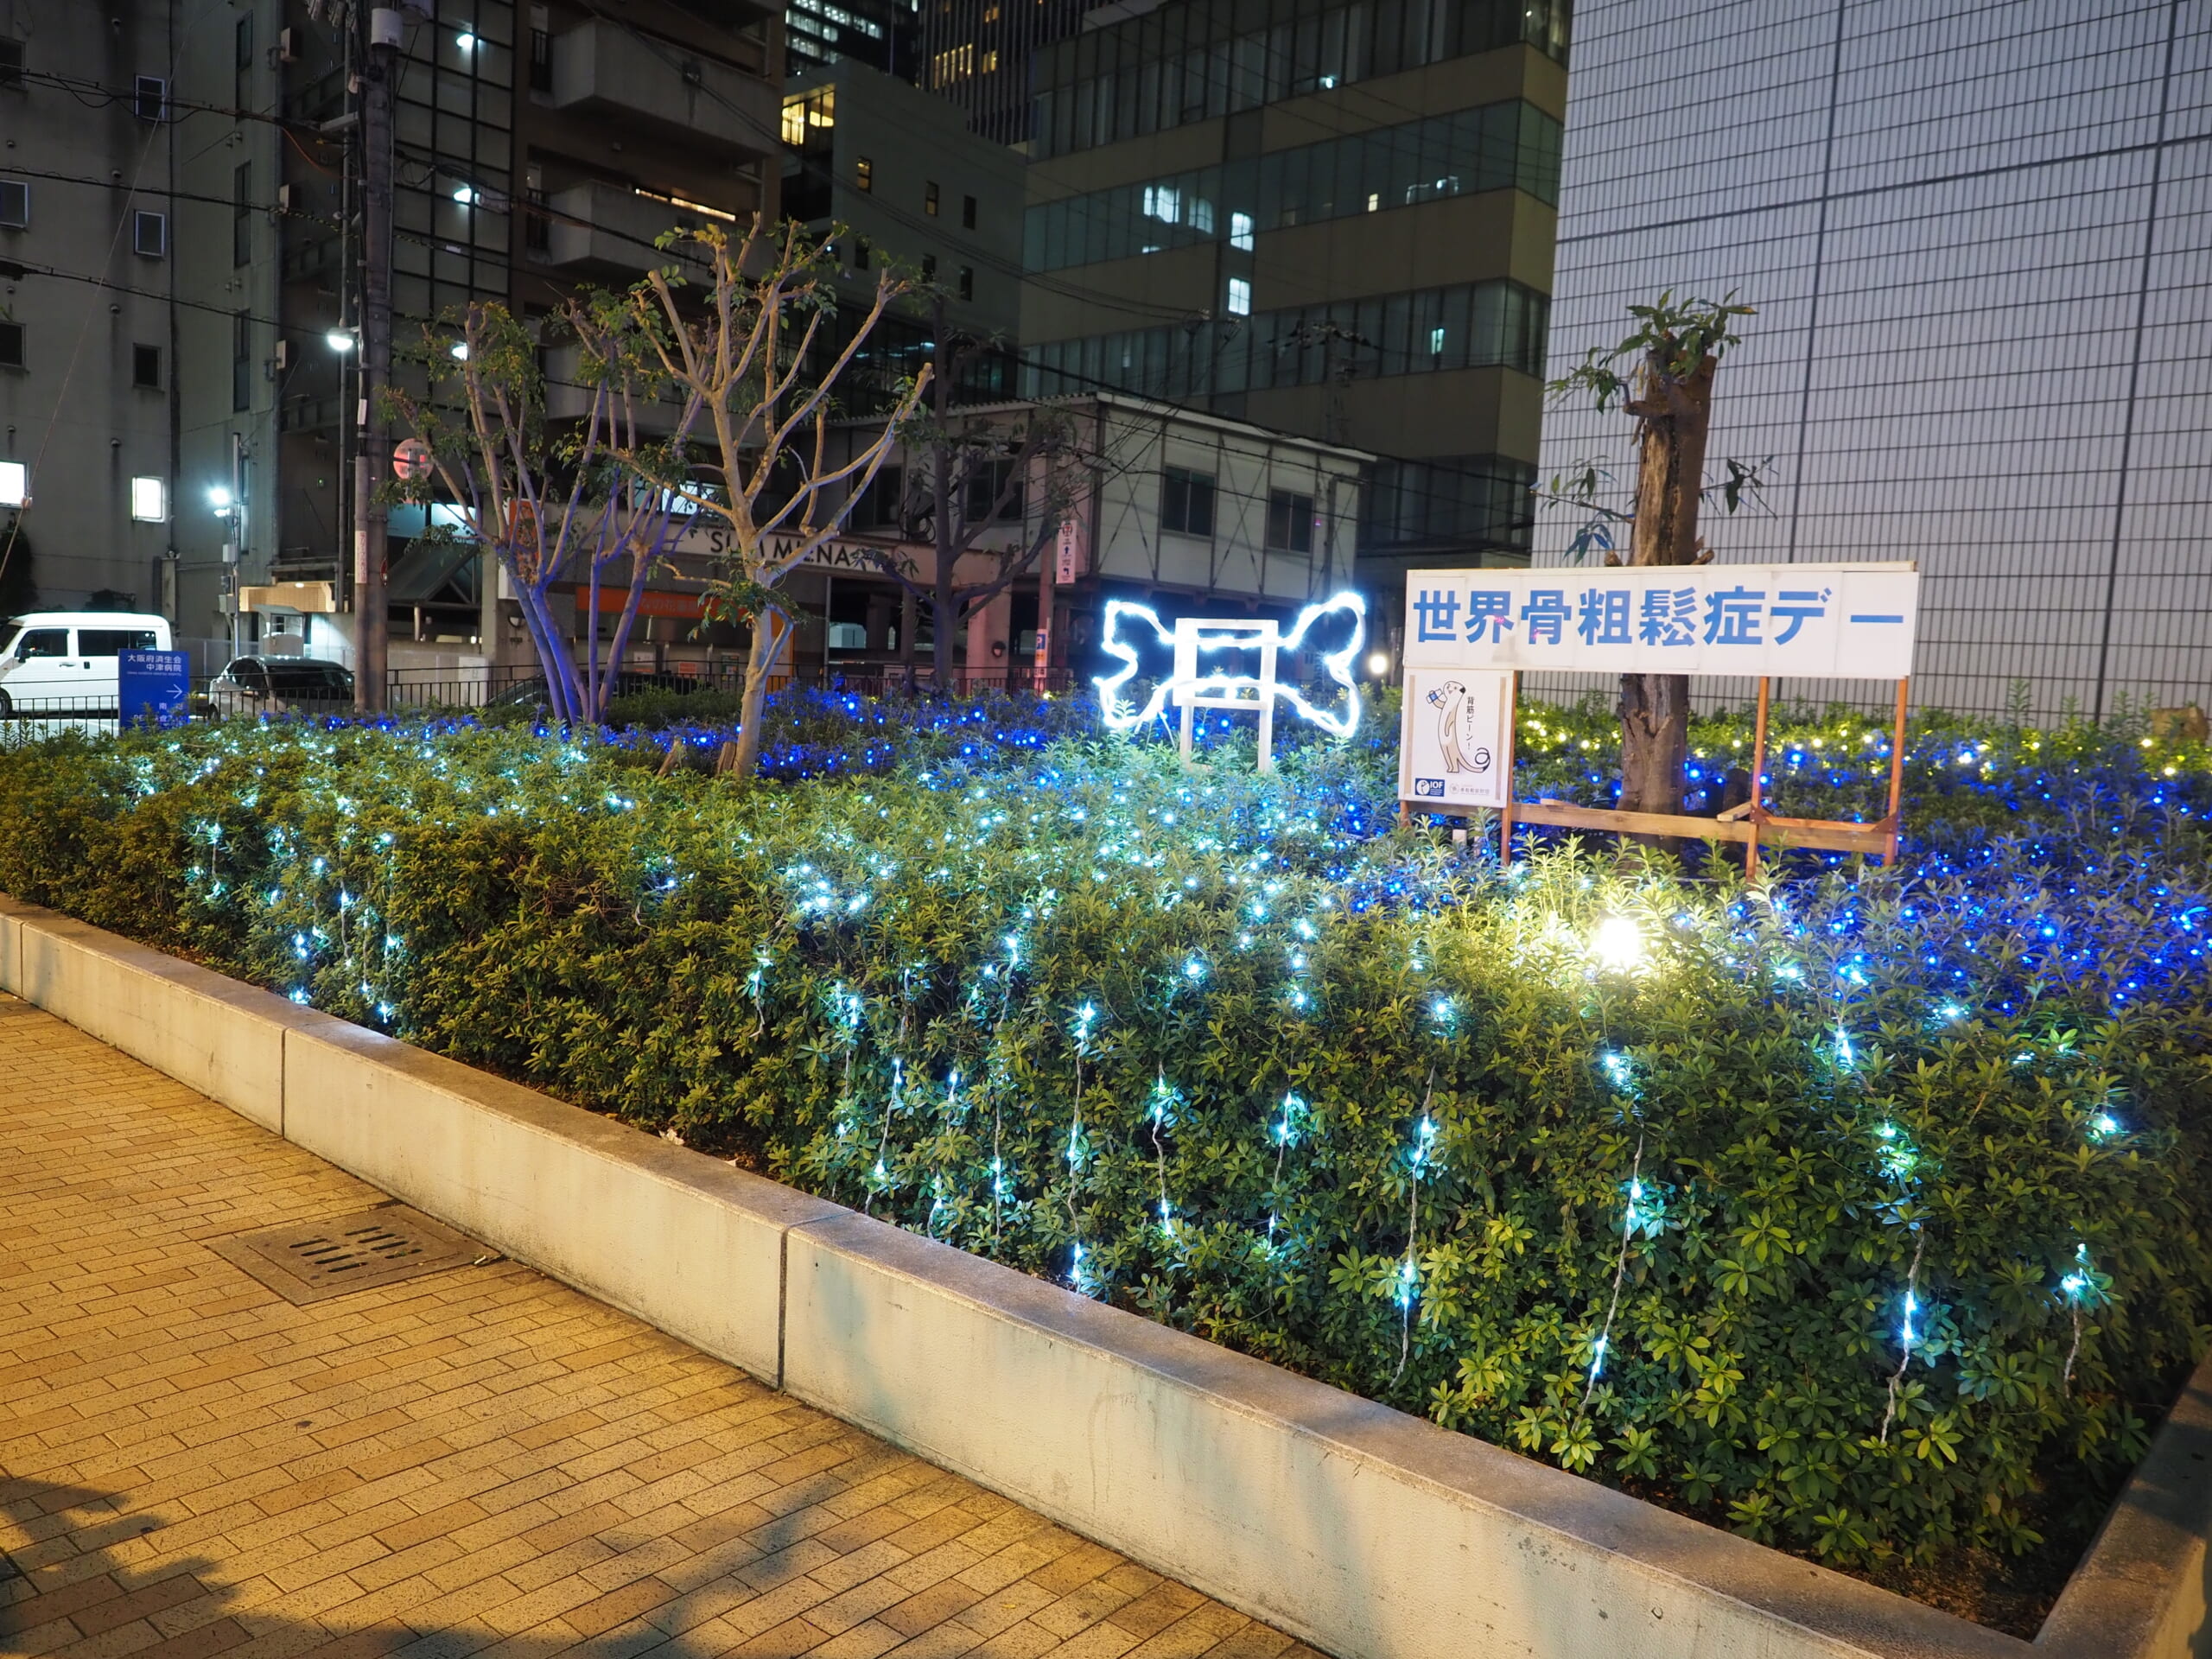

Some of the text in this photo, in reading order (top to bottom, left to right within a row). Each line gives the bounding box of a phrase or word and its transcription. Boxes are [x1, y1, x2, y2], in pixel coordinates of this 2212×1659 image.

[1413, 585, 1904, 647] 世界骨粗鬆症デー
[127, 654, 182, 664] 大阪府済生会
[146, 664, 182, 672] 中津病院
